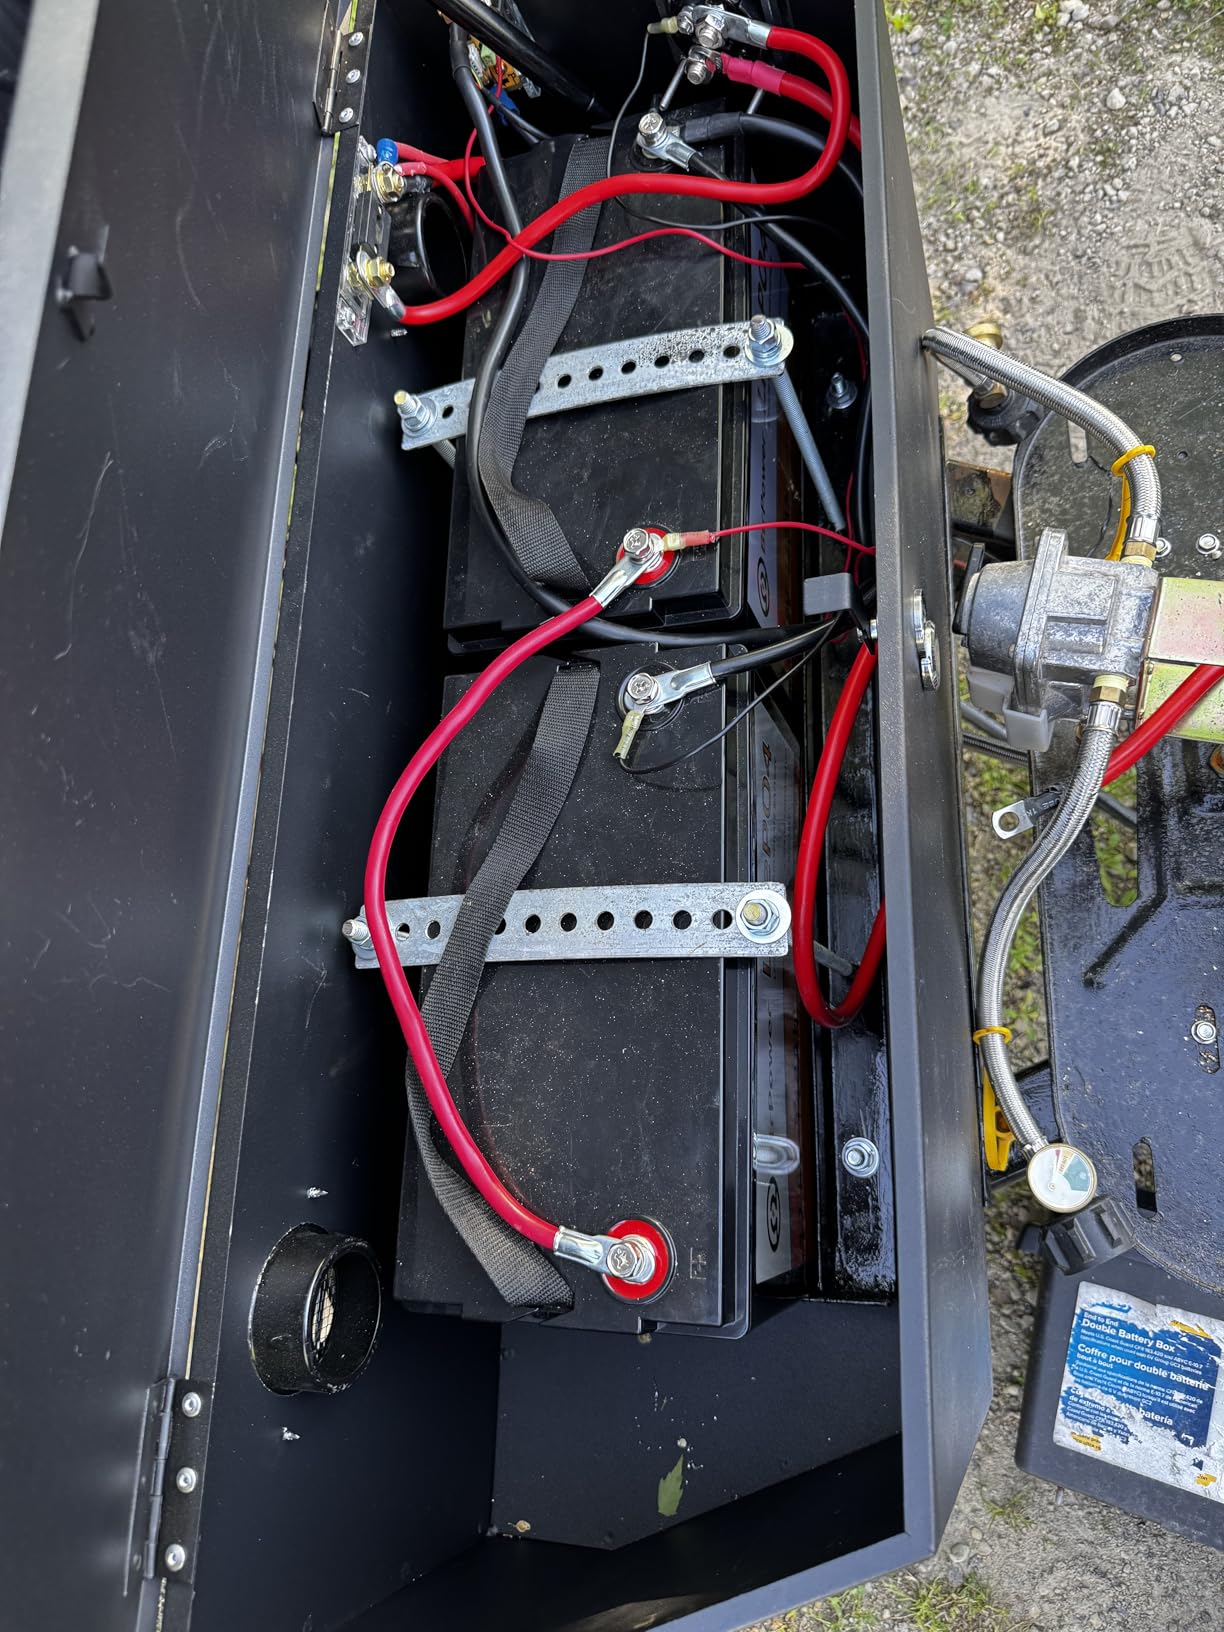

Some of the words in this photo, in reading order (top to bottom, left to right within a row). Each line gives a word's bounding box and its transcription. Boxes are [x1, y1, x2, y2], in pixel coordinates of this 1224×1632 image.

[1105, 1318, 1118, 1326] End
[1081, 1317, 1117, 1335] Double
[1117, 1328, 1154, 1347] Battery
[1155, 1340, 1175, 1352] Box
[1076, 1352, 1092, 1361] bout
[1098, 1359, 1113, 1368] bout
[1077, 1343, 1108, 1358] Coffre
[1108, 1354, 1132, 1368] pour
[1134, 1360, 1168, 1377] double
[1169, 1370, 1209, 1390] batterie
[1138, 1407, 1174, 1425] batería
